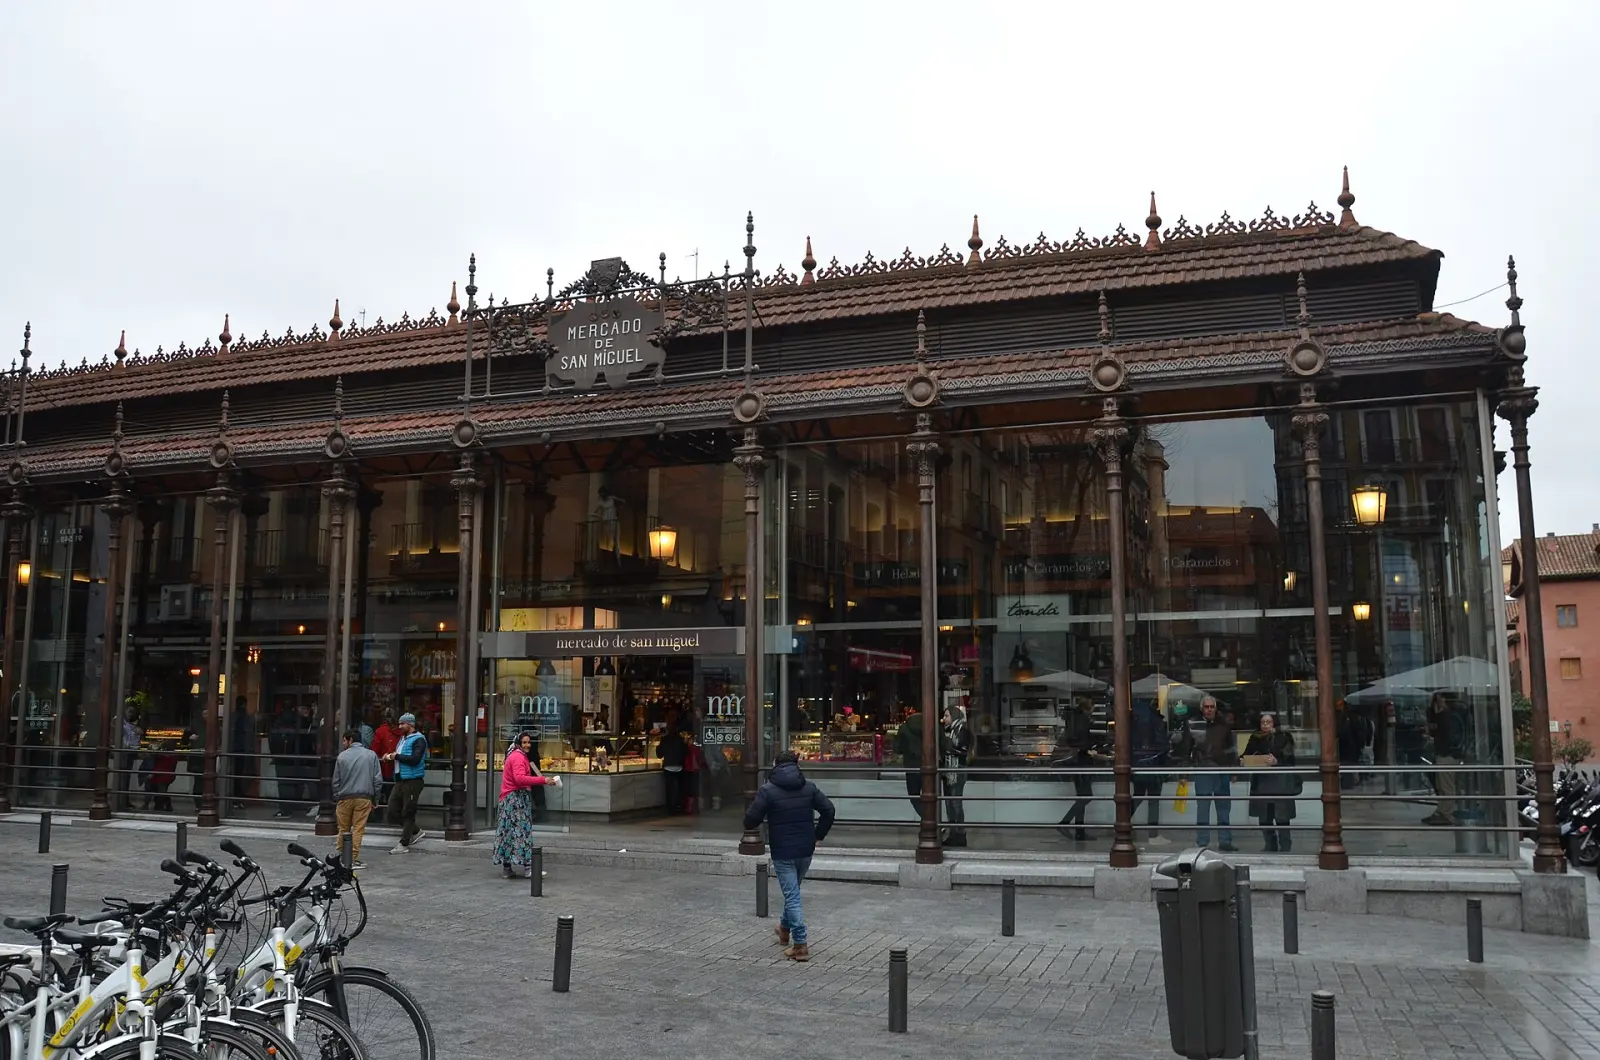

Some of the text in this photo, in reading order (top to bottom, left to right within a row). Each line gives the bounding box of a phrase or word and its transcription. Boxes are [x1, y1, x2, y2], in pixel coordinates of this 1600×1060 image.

[567, 318, 641, 340] MERCADO
[594, 338, 613, 349] DE
[560, 348, 643, 370] SAN MIGUEL
[1171, 555, 1231, 568] Caramelos
[892, 566, 921, 580] Helad
[556, 633, 700, 652] mercado de san miguel
